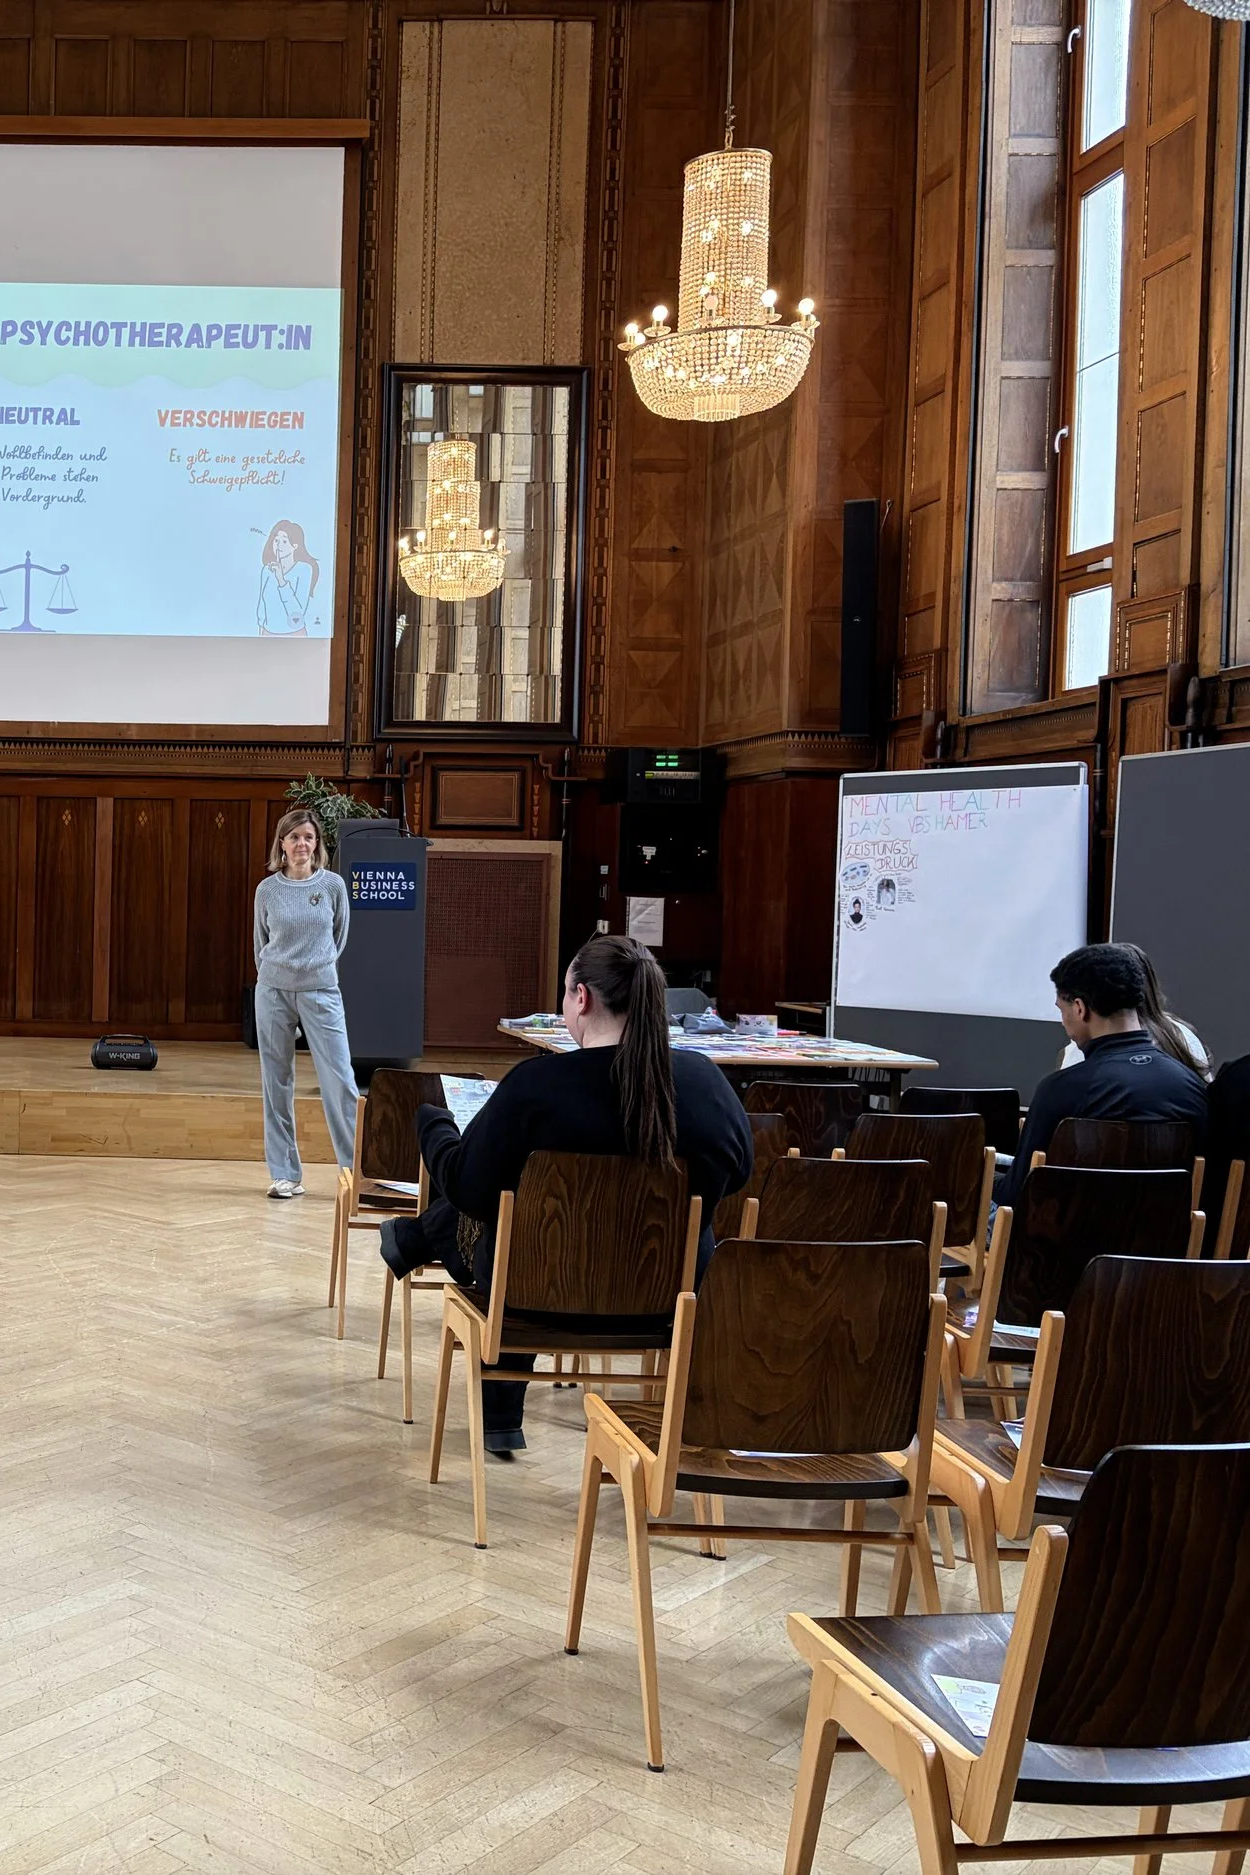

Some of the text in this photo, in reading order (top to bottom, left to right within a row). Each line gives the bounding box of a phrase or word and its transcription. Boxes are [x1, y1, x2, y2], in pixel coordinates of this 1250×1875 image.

[0, 319, 312, 350] PSYCHOTHERAPEUT:IN
[157, 409, 305, 429] VERSCHWIEGEN
[79, 447, 107, 461] und
[169, 448, 306, 471] Es gilt eine gesetzliche
[1, 465, 56, 481] Probleme
[63, 467, 98, 482] stehen
[188, 470, 286, 492] Schweigepflicht!
[1, 487, 87, 510] Vordergrund.
[850, 789, 1022, 817] MENTAL HEALTH
[848, 818, 891, 838] DAYS
[847, 842, 909, 857] LEISTUNGS
[876, 856, 916, 870] DRUCK
[352, 871, 405, 879] VIENNA
[352, 881, 415, 890] BUSINESS
[352, 891, 405, 900] SCHOOL
